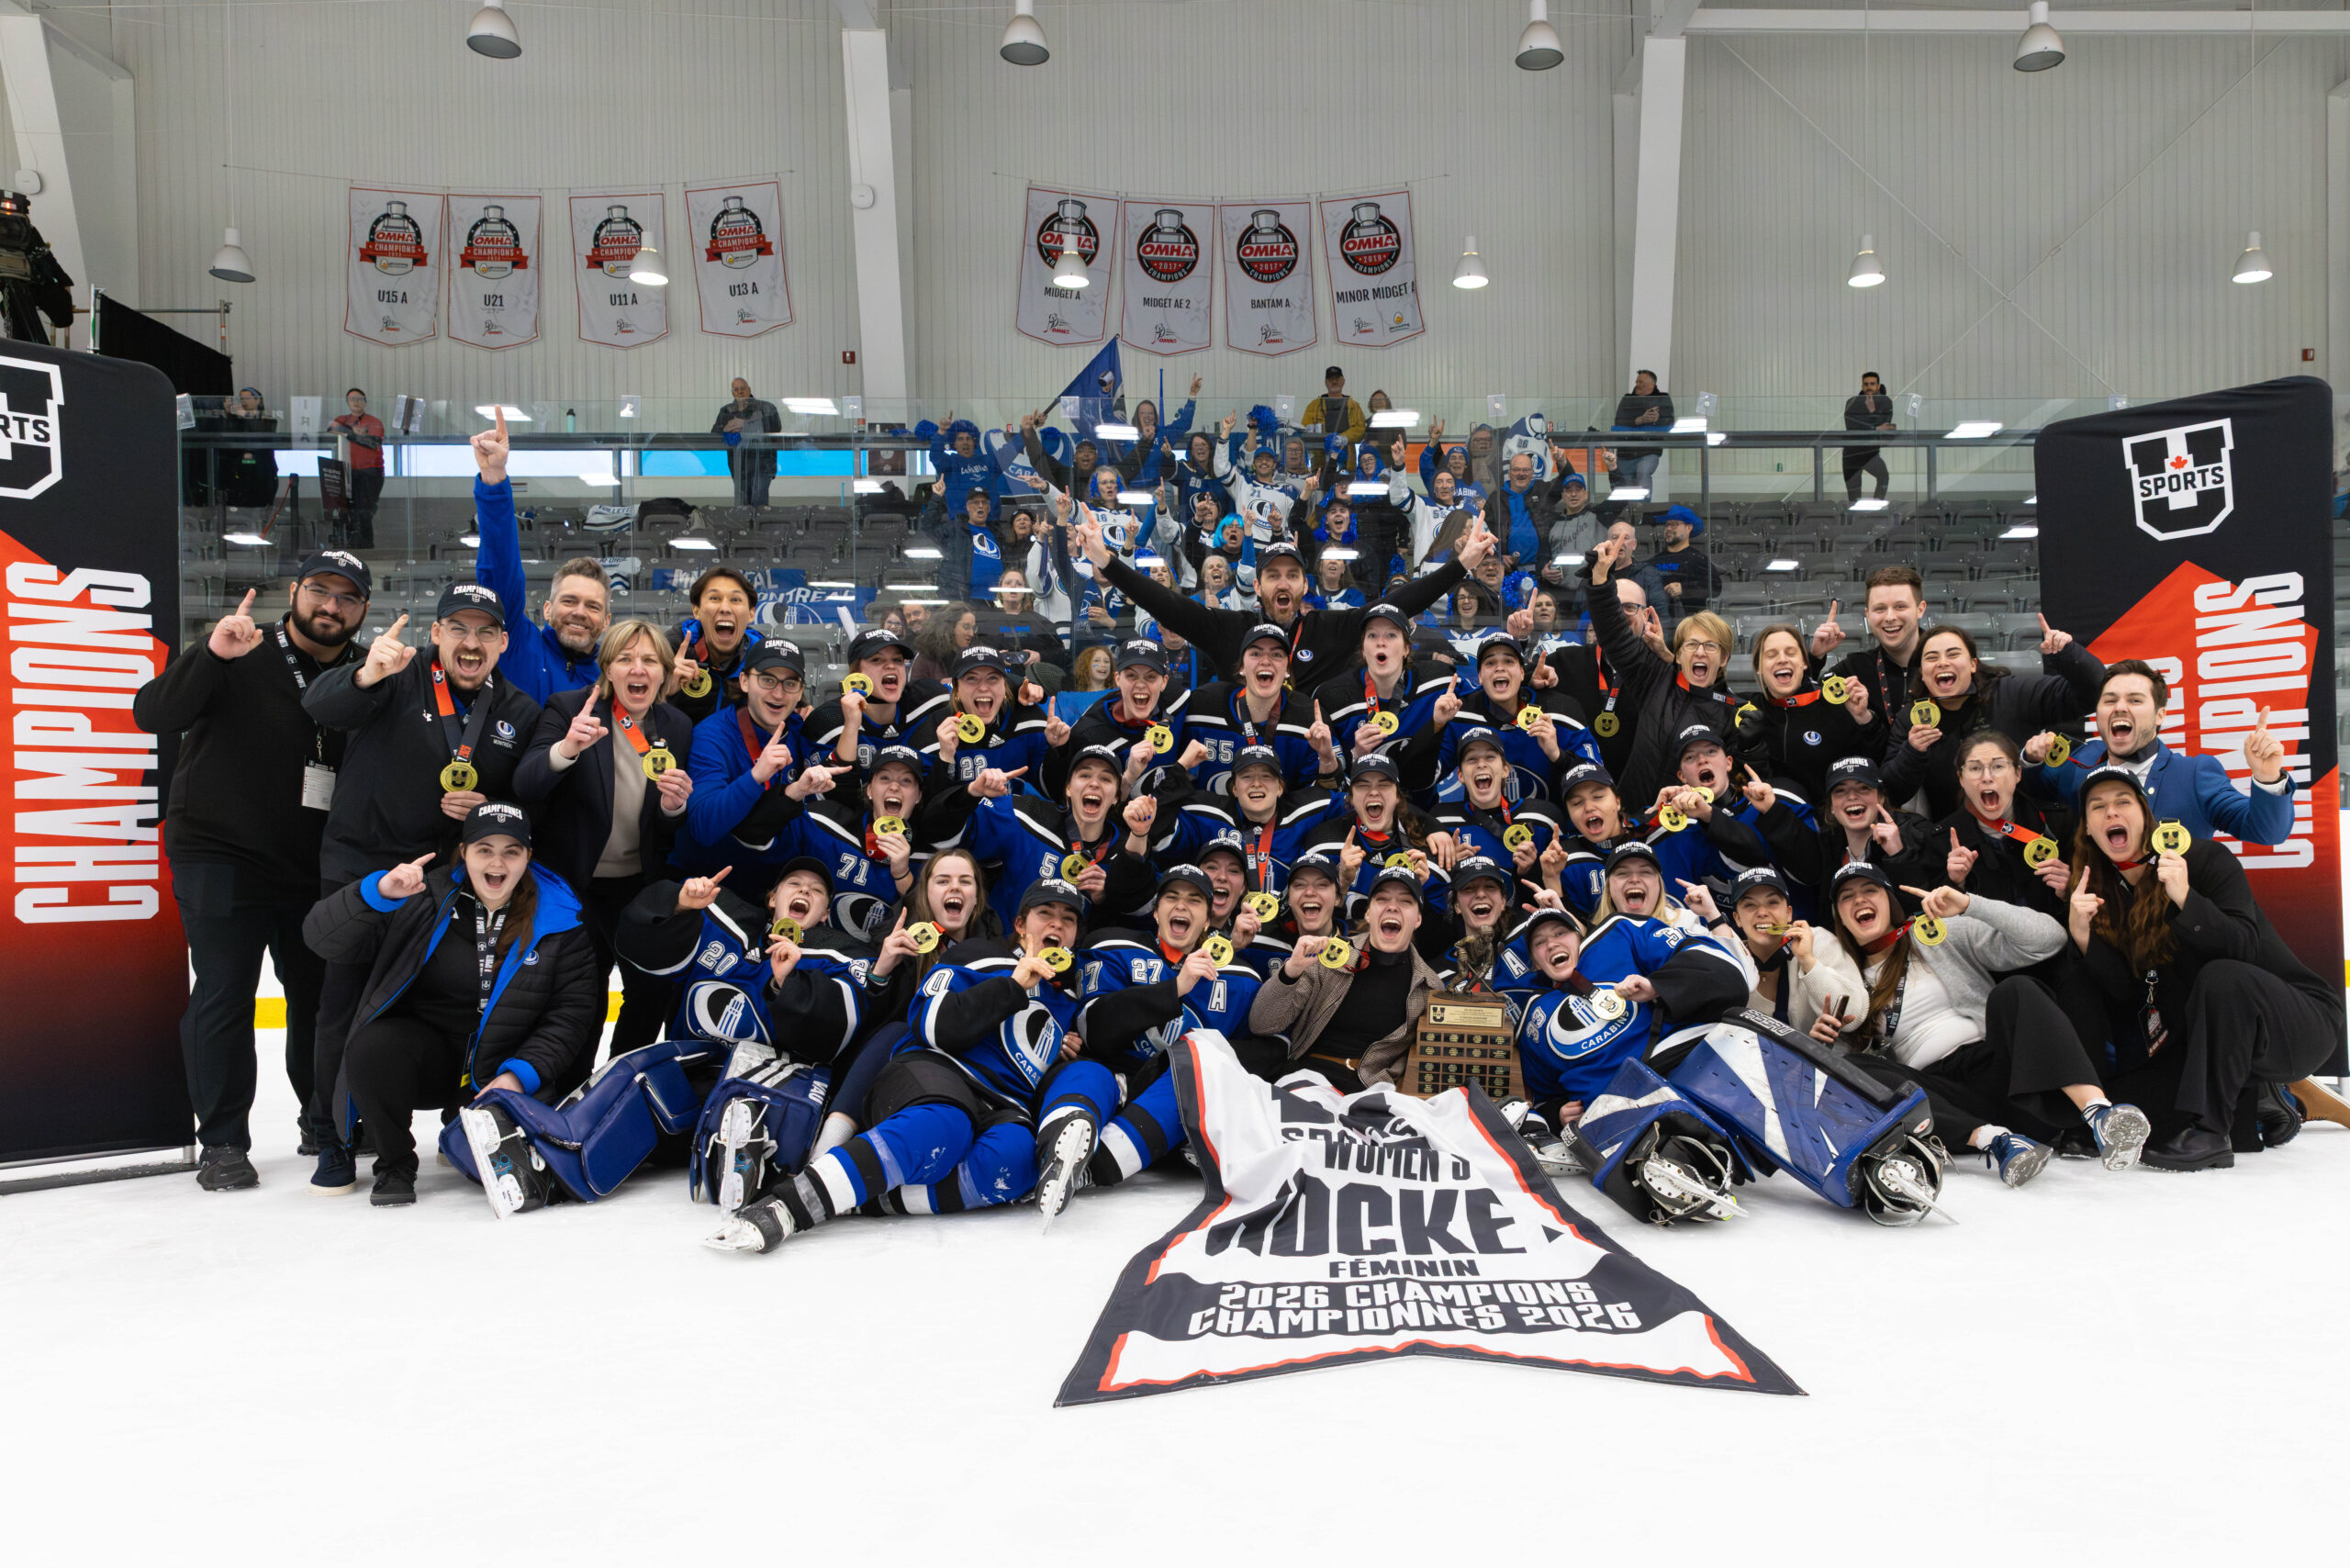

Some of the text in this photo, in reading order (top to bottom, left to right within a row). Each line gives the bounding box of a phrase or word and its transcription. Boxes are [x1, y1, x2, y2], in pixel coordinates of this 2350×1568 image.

[375, 231, 415, 243] OMHA
[717, 225, 755, 238] OMHA
[375, 243, 416, 254] CHAMPIONS
[474, 236, 514, 246] OMHA
[599, 235, 640, 246] OMHA
[718, 237, 758, 249] CHAMPIONS
[1344, 235, 1396, 252] OMHA
[473, 248, 514, 257] CHAMPIONS
[599, 247, 642, 257] CHAMPION
[1141, 243, 1194, 258] OMHA
[1240, 243, 1293, 258] OMHA
[1147, 267, 1188, 282] CHAMPIONS
[1158, 263, 1178, 271] 2017
[1354, 259, 1393, 274] CHAMPIONS
[1248, 268, 1289, 283] CHAMPIONS
[378, 289, 408, 304] U15 A
[729, 281, 759, 297] U13 A
[1044, 286, 1081, 300] MIDGET A
[1336, 288, 1370, 304] MINOR
[1371, 283, 1408, 300] MIDGET
[484, 294, 504, 308] U21
[610, 293, 638, 307] U11 A
[1143, 297, 1191, 309] MIDGET AE 2
[1250, 297, 1291, 309] BANTAM A
[0, 413, 50, 443] RTS
[2139, 465, 2225, 498] SPORTS
[453, 585, 497, 603] CHAMPIONNES
[5, 561, 160, 924] CHAMPIONS
[857, 744, 877, 769] 9
[1204, 737, 1234, 765] 55
[960, 755, 989, 780] 22
[478, 804, 523, 821] CHAMPIONNES
[836, 853, 869, 886] 71
[1039, 852, 1058, 879] 5
[698, 940, 738, 977] 20
[1501, 947, 1528, 980] A
[1131, 958, 1163, 984] 27
[1207, 979, 1227, 1013] A
[1581, 1010, 1630, 1050] CARABINS
[1324, 1141, 1471, 1182] WOMENS
[1329, 1258, 1481, 1279] FÉMININ
[1219, 1281, 1598, 1310] 2026 CHAMPIONS
[1187, 1301, 1642, 1337] CHAMPIONNES 2026
